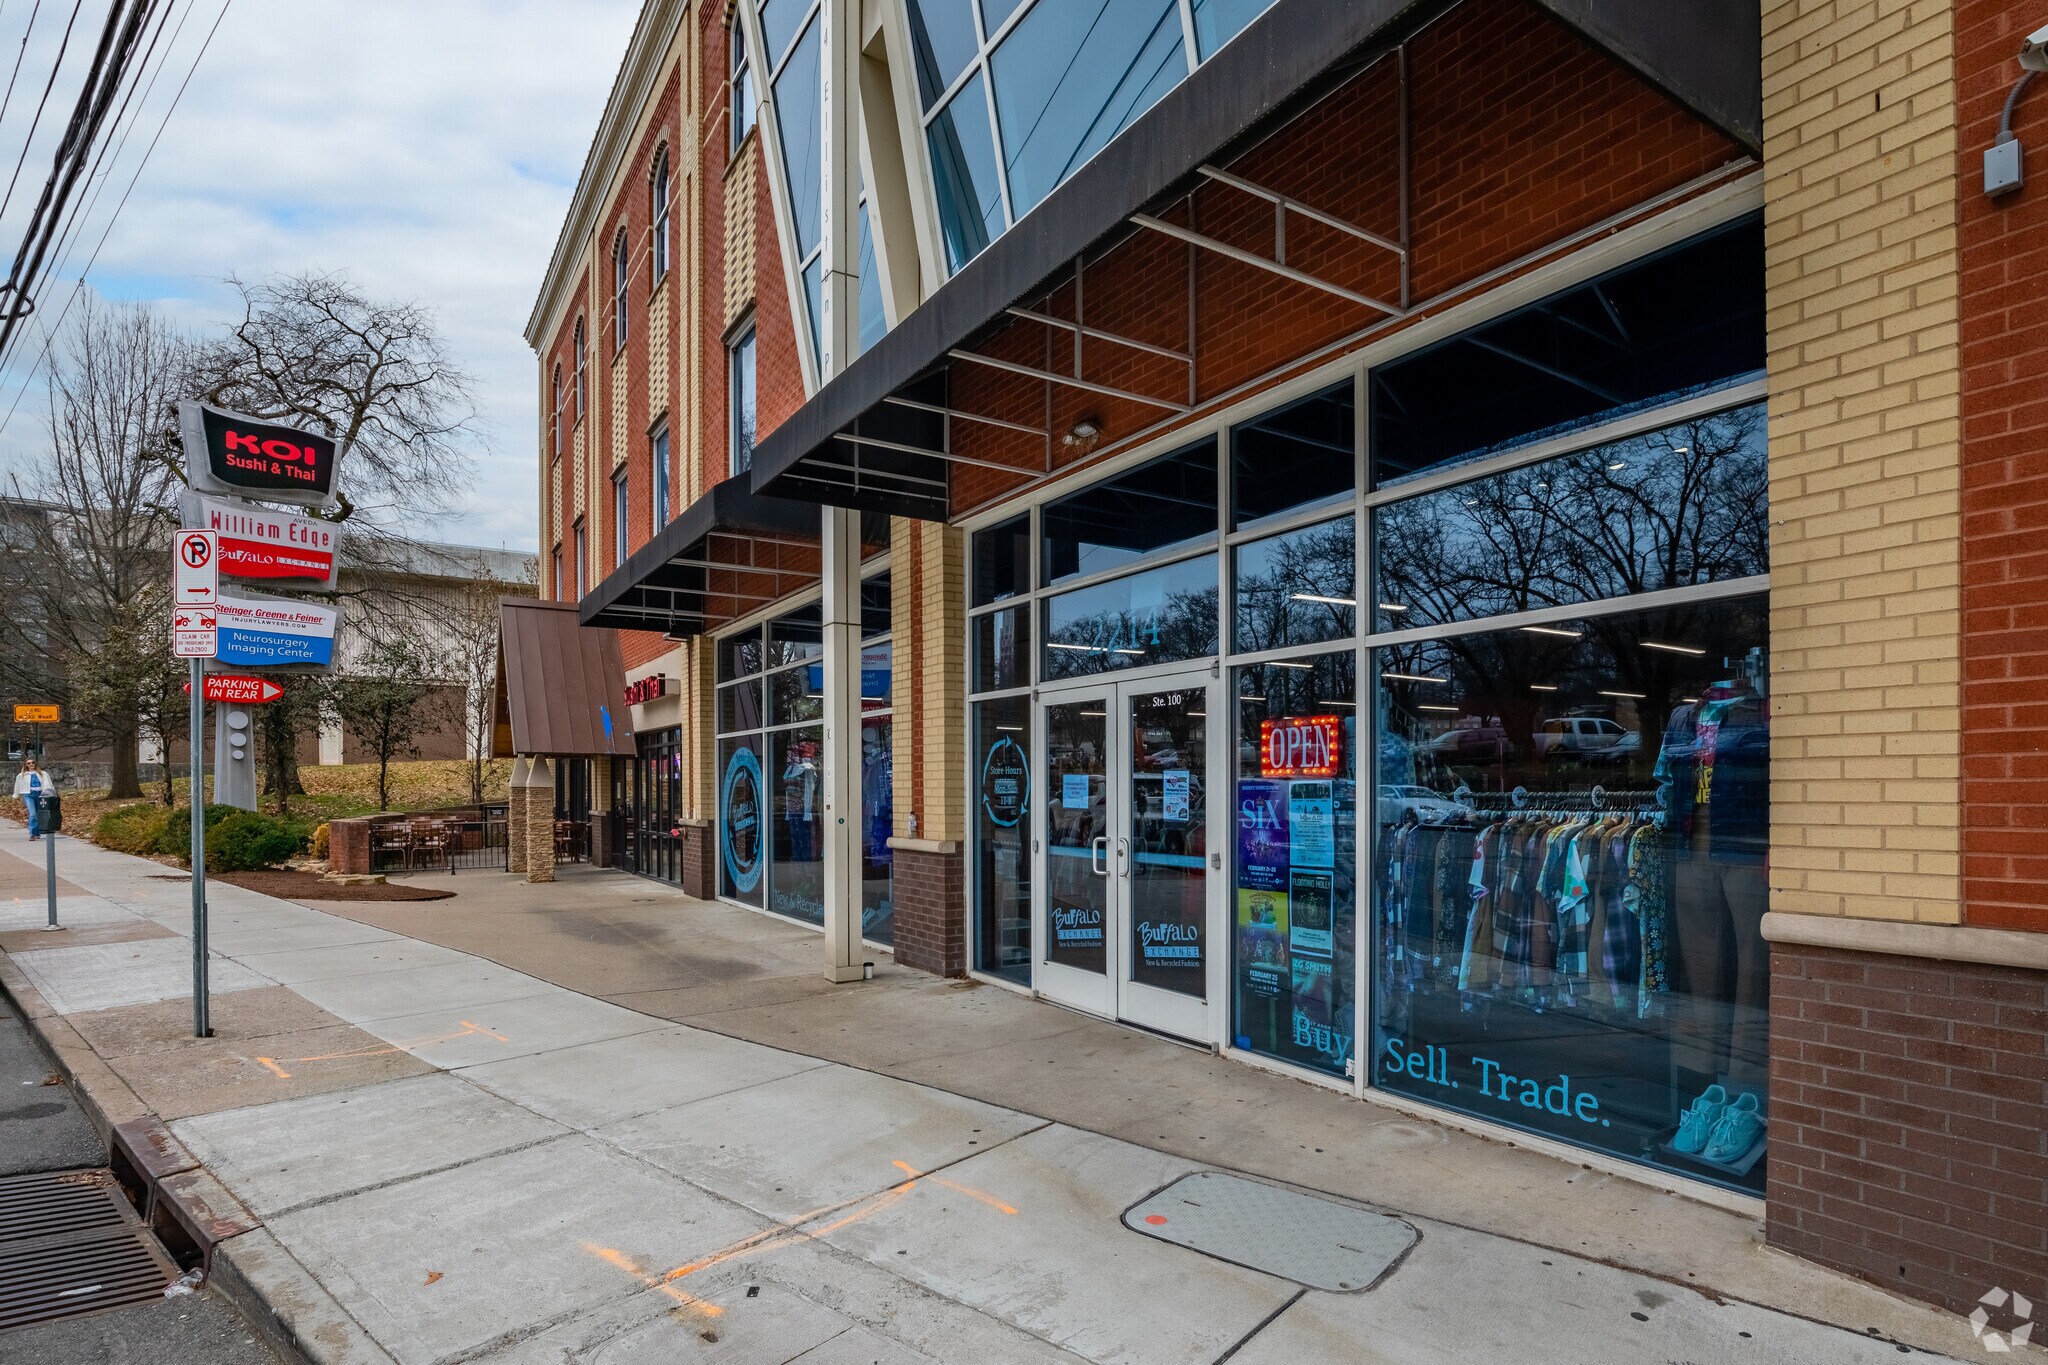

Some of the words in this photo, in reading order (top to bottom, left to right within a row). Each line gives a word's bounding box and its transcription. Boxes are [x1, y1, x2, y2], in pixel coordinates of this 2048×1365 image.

[225, 430, 316, 466] KOI
[225, 453, 267, 473] Sushi
[270, 462, 281, 475] &
[285, 464, 316, 482] Thai
[293, 517, 318, 527] AVEDA
[211, 510, 280, 539] William
[289, 523, 329, 548] Edge
[215, 603, 254, 618] Steinger,
[255, 607, 287, 620] Greene
[288, 612, 294, 621] &
[295, 612, 324, 624] Feiner
[232, 616, 307, 629] INJURYLAWYERS.COM
[233, 632, 309, 649] Neurosurgery
[227, 642, 275, 658] Imaging
[277, 647, 314, 659] Center
[207, 678, 260, 691] PARKING
[209, 687, 223, 698] IN
[226, 689, 258, 700] REAR
[1152, 696, 1166, 707] Ste.
[1168, 694, 1182, 706] 100
[1269, 725, 1332, 768] OPEN
[990, 766, 1004, 775] Store
[1005, 765, 1023, 775] Hours
[1292, 877, 1315, 888] FLOGGING
[1315, 879, 1331, 890] MOLLY
[796, 894, 824, 918] Recycle
[1057, 929, 1102, 939] EXCHANGE
[1071, 941, 1087, 949] Recycled
[1145, 947, 1199, 957] EXCHANGE
[1161, 959, 1181, 968] Recycled
[1181, 959, 1200, 967] Fashion
[1304, 961, 1332, 974] SMITH
[1249, 969, 1271, 979] FEBRUARY
[1294, 1013, 1352, 1066] Buy
[1386, 1037, 1459, 1089] Sell.
[1471, 1056, 1611, 1127] Trade.
